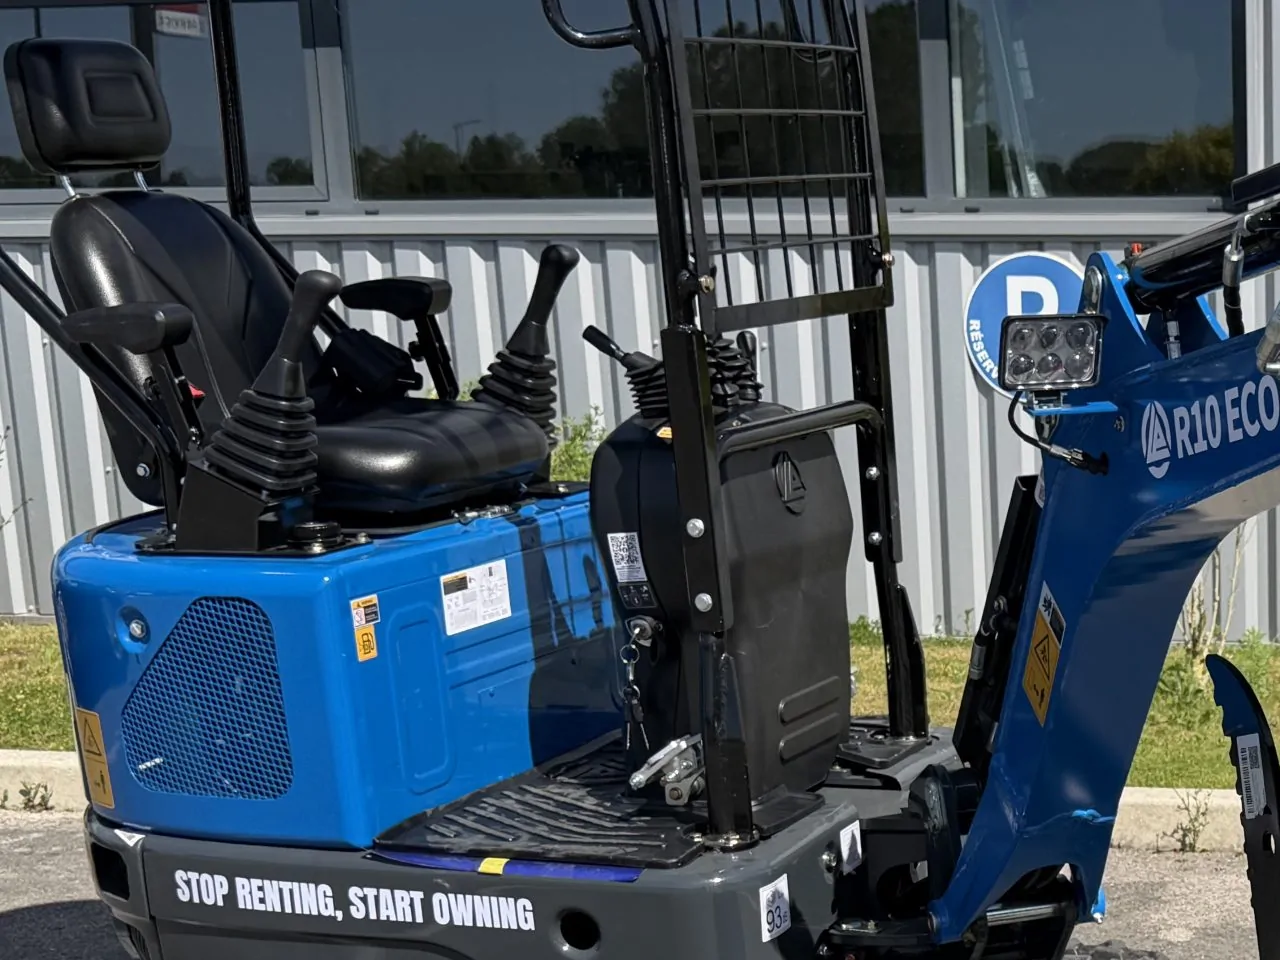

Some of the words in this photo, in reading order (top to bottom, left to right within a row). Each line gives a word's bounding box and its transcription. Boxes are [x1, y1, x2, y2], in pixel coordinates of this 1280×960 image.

[1006, 275, 1059, 315] P
[969, 319, 999, 379] RÉSERV
[1173, 394, 1222, 459] R10
[1224, 374, 1280, 443] ECO
[174, 869, 229, 906] STOP
[234, 876, 344, 922] RENTING,
[348, 886, 425, 923] START
[431, 892, 536, 931] OWNING
[766, 905, 782, 933] 93
